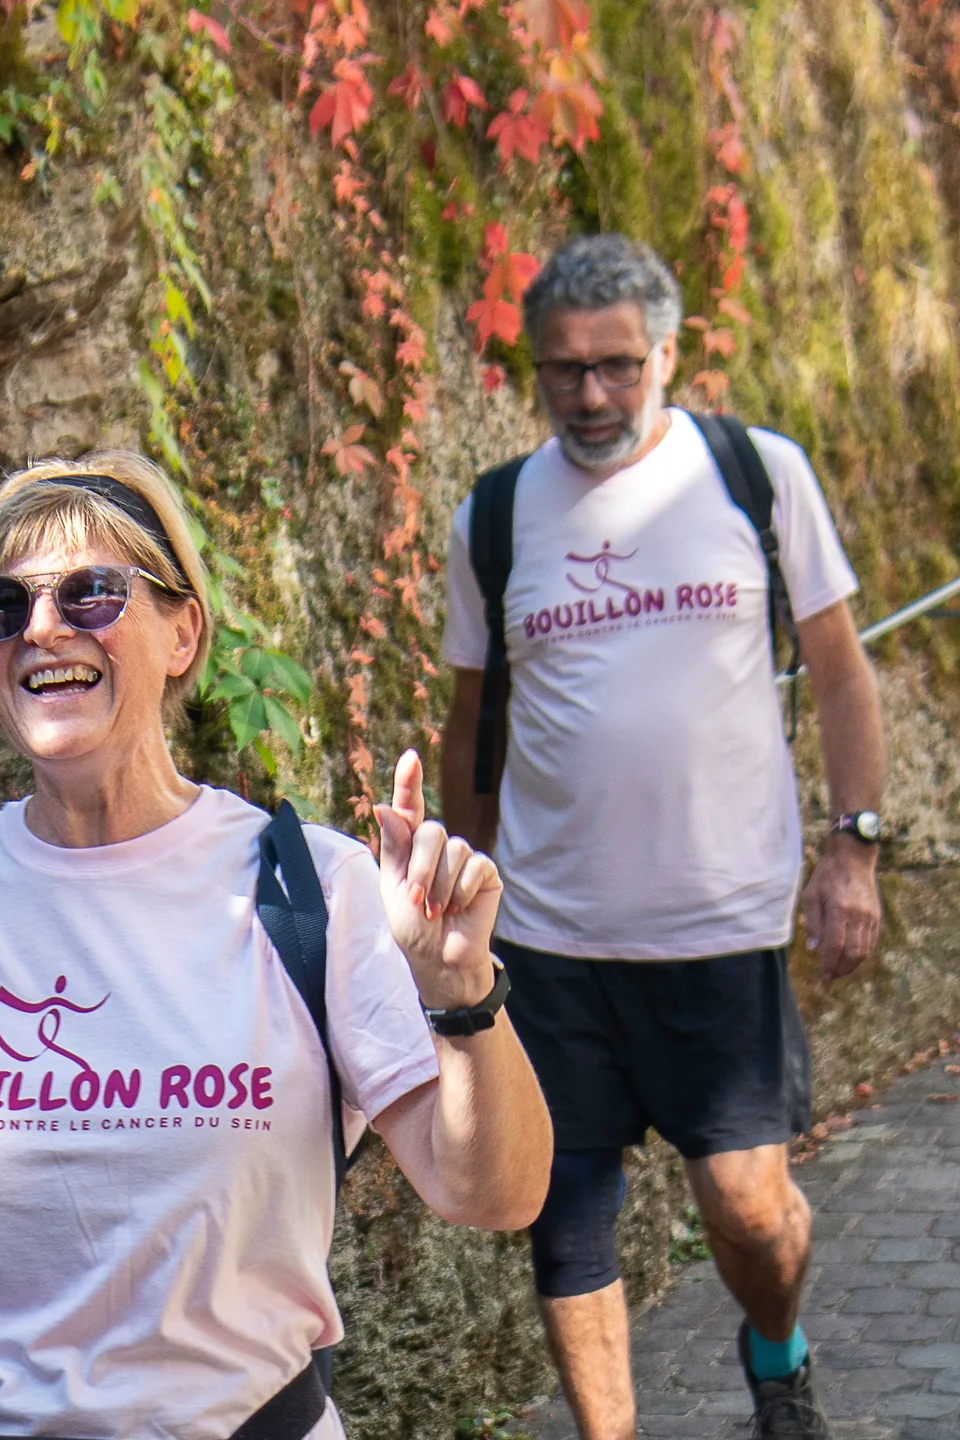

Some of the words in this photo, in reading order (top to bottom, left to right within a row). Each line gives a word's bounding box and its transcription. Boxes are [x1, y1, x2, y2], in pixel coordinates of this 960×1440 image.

[523, 587, 665, 638] BOUILLON
[675, 581, 738, 611] ROSE
[159, 1062, 274, 1110] ROSE
[70, 1119, 91, 1131] LE
[101, 1116, 183, 1130] CANCER
[194, 1116, 220, 1128] DU
[231, 1117, 272, 1131] SEIN
